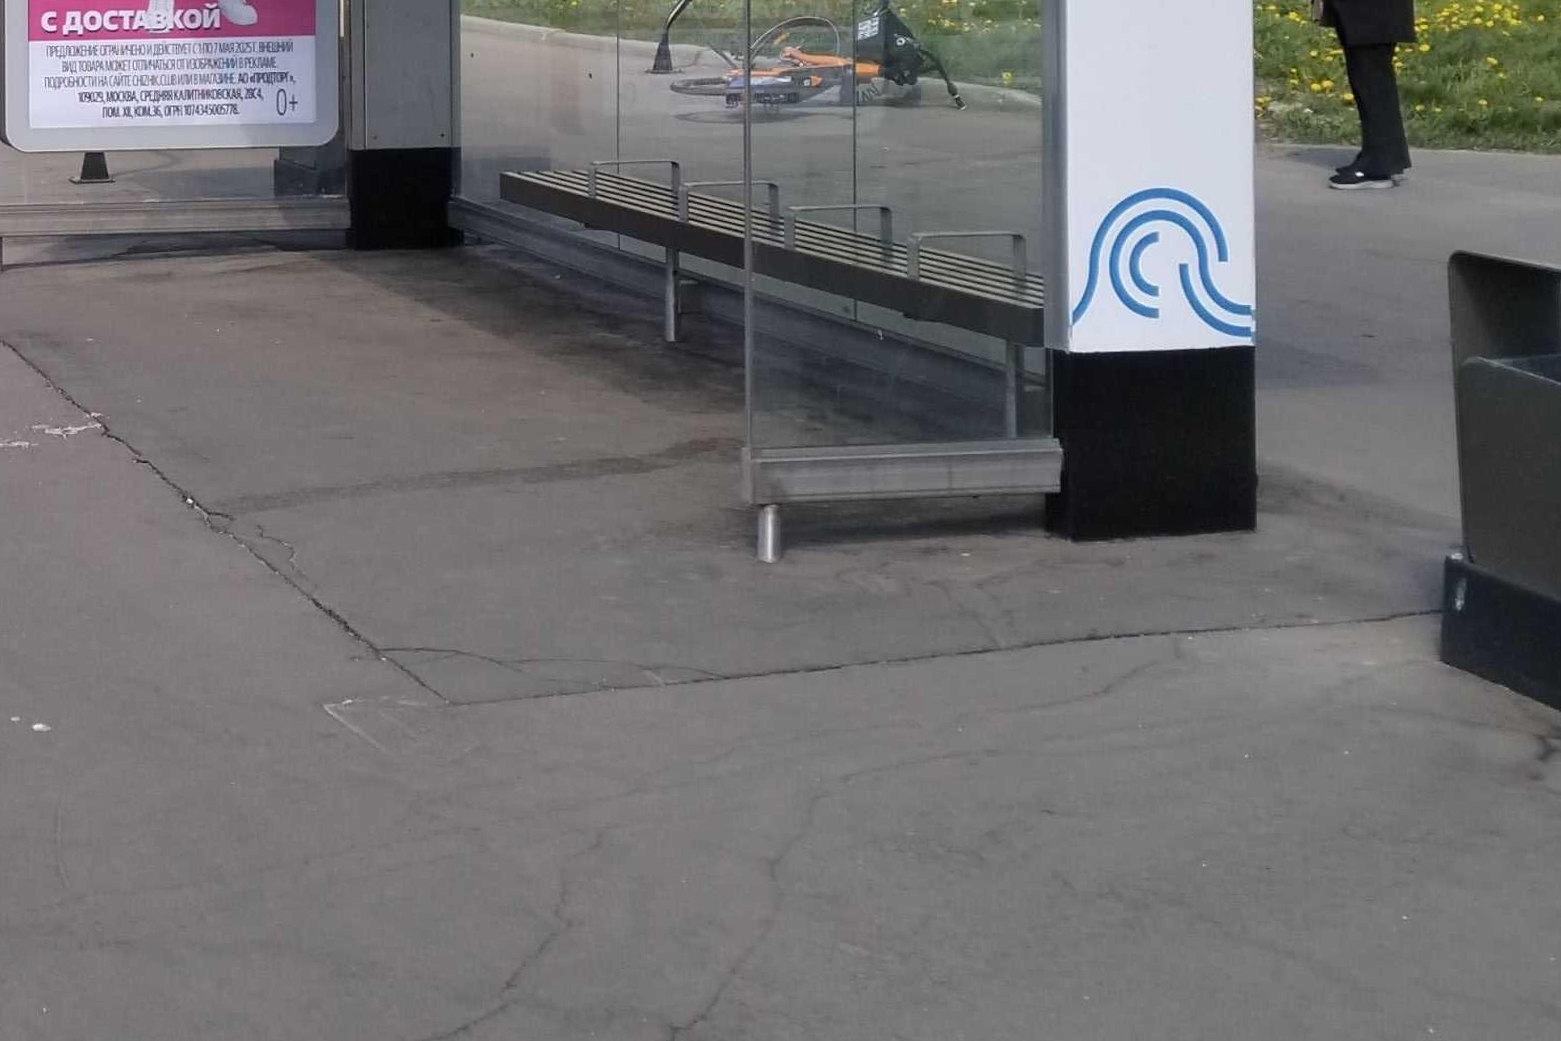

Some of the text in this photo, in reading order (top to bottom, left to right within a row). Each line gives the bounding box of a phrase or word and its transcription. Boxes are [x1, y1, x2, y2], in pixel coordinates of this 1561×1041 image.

[40, 3, 222, 36] С ДОСТАВКОЙ
[275, 88, 299, 117] 0+
